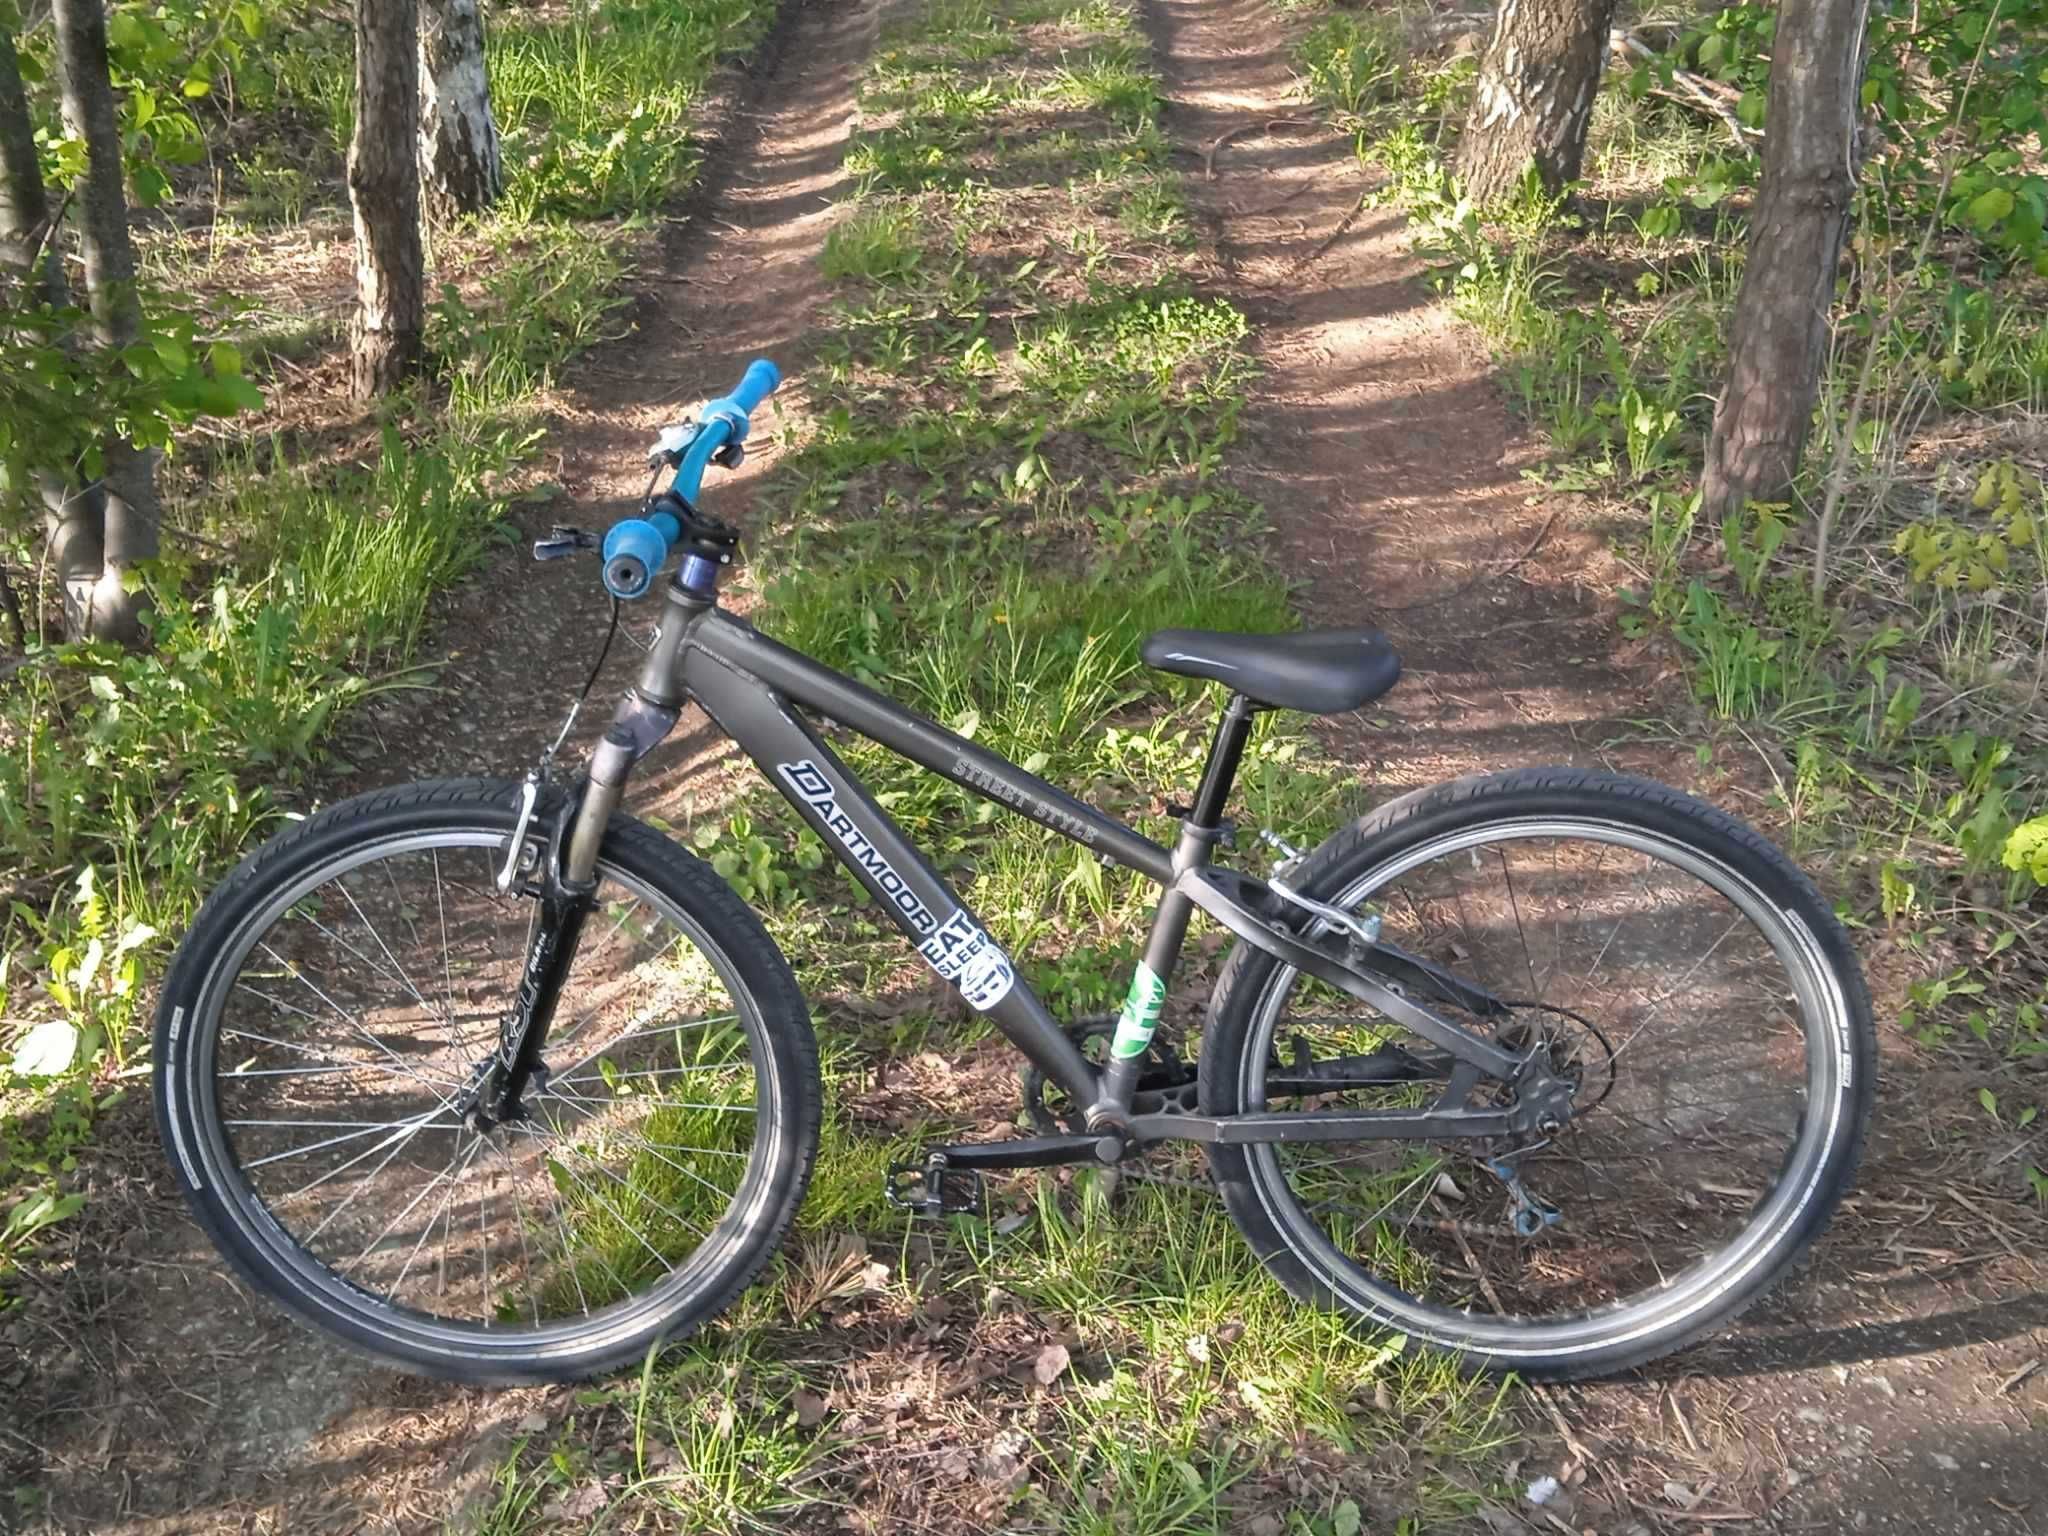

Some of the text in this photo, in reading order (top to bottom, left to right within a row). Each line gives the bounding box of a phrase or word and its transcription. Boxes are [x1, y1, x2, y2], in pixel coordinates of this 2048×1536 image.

[951, 759, 1098, 844] STREET STYLE
[778, 760, 938, 935] DARTMOOR
[920, 912, 973, 966] EAT
[938, 931, 986, 977] SLEEP
